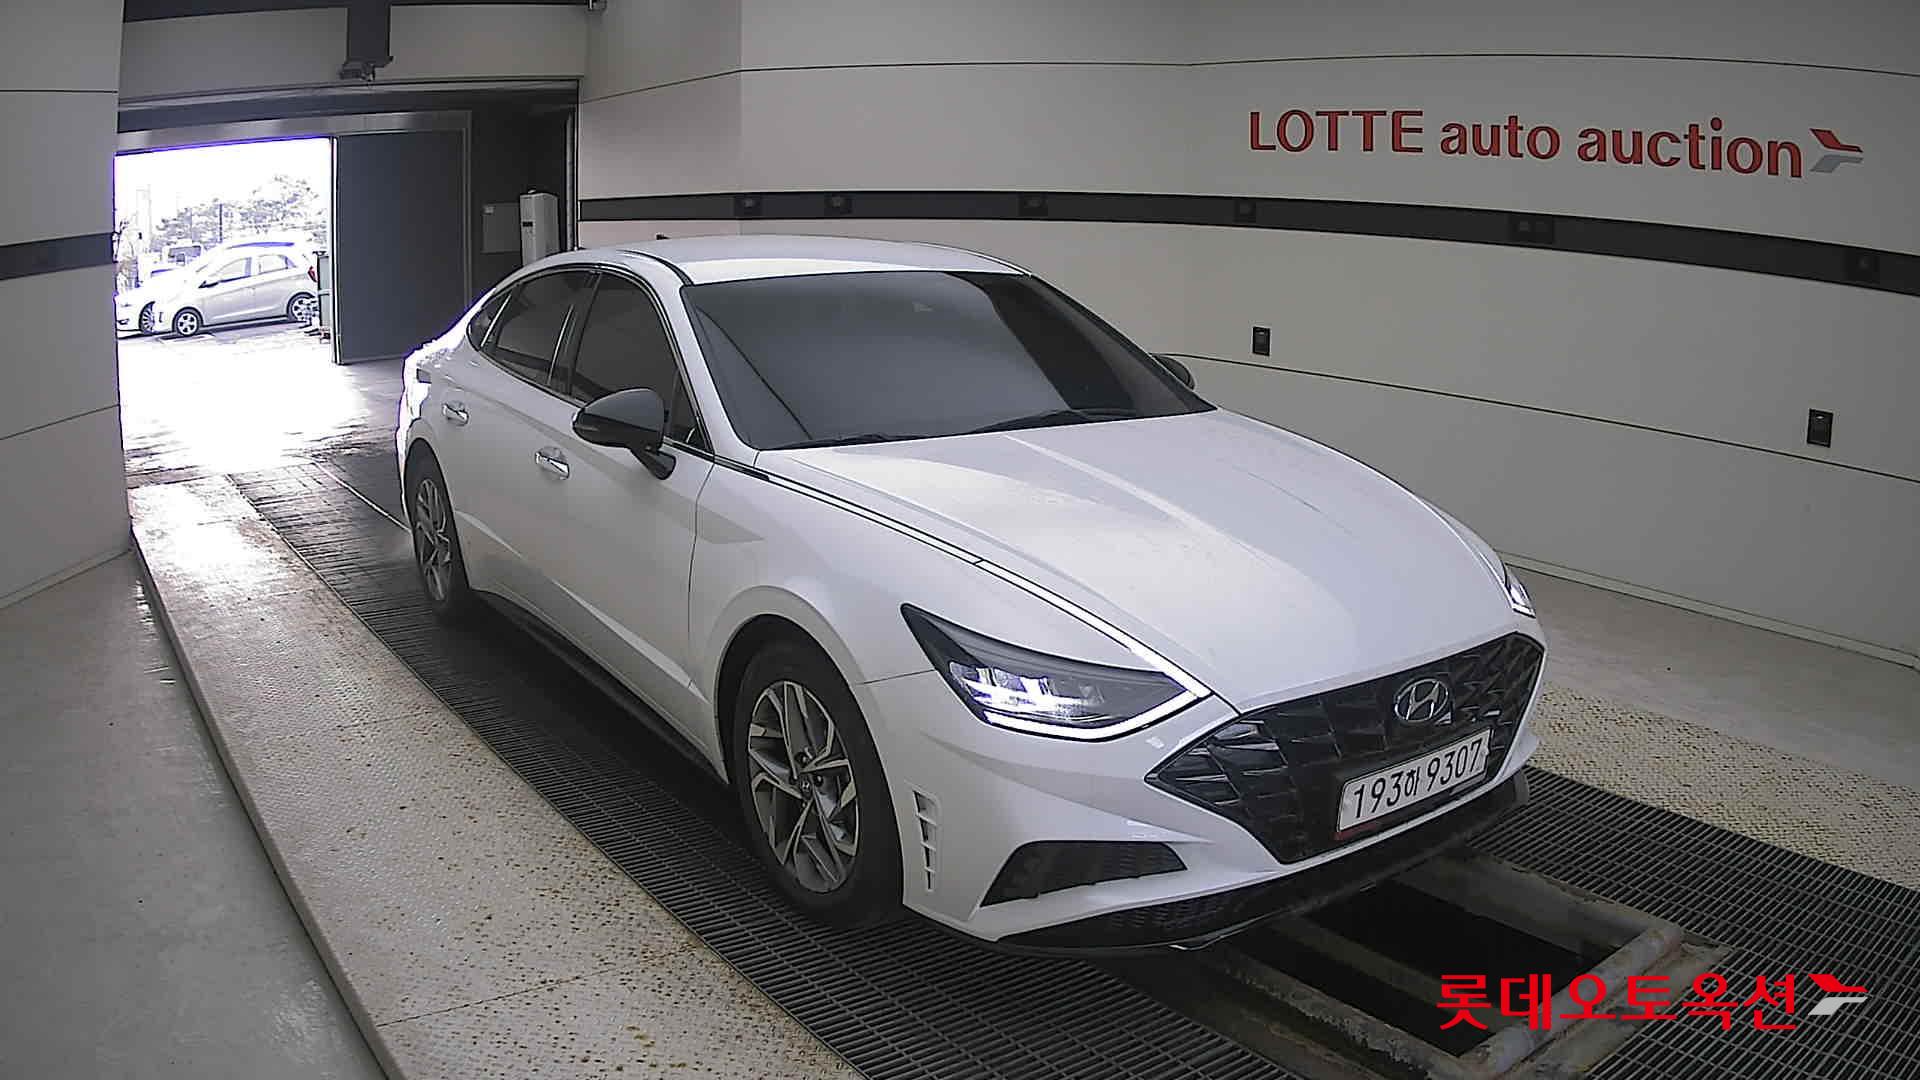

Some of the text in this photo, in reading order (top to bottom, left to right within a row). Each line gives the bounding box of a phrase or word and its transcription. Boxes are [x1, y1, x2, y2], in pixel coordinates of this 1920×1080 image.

[1250, 110, 1803, 178] LOTTE auto auction
[1353, 737, 1483, 819] 193하 9307
